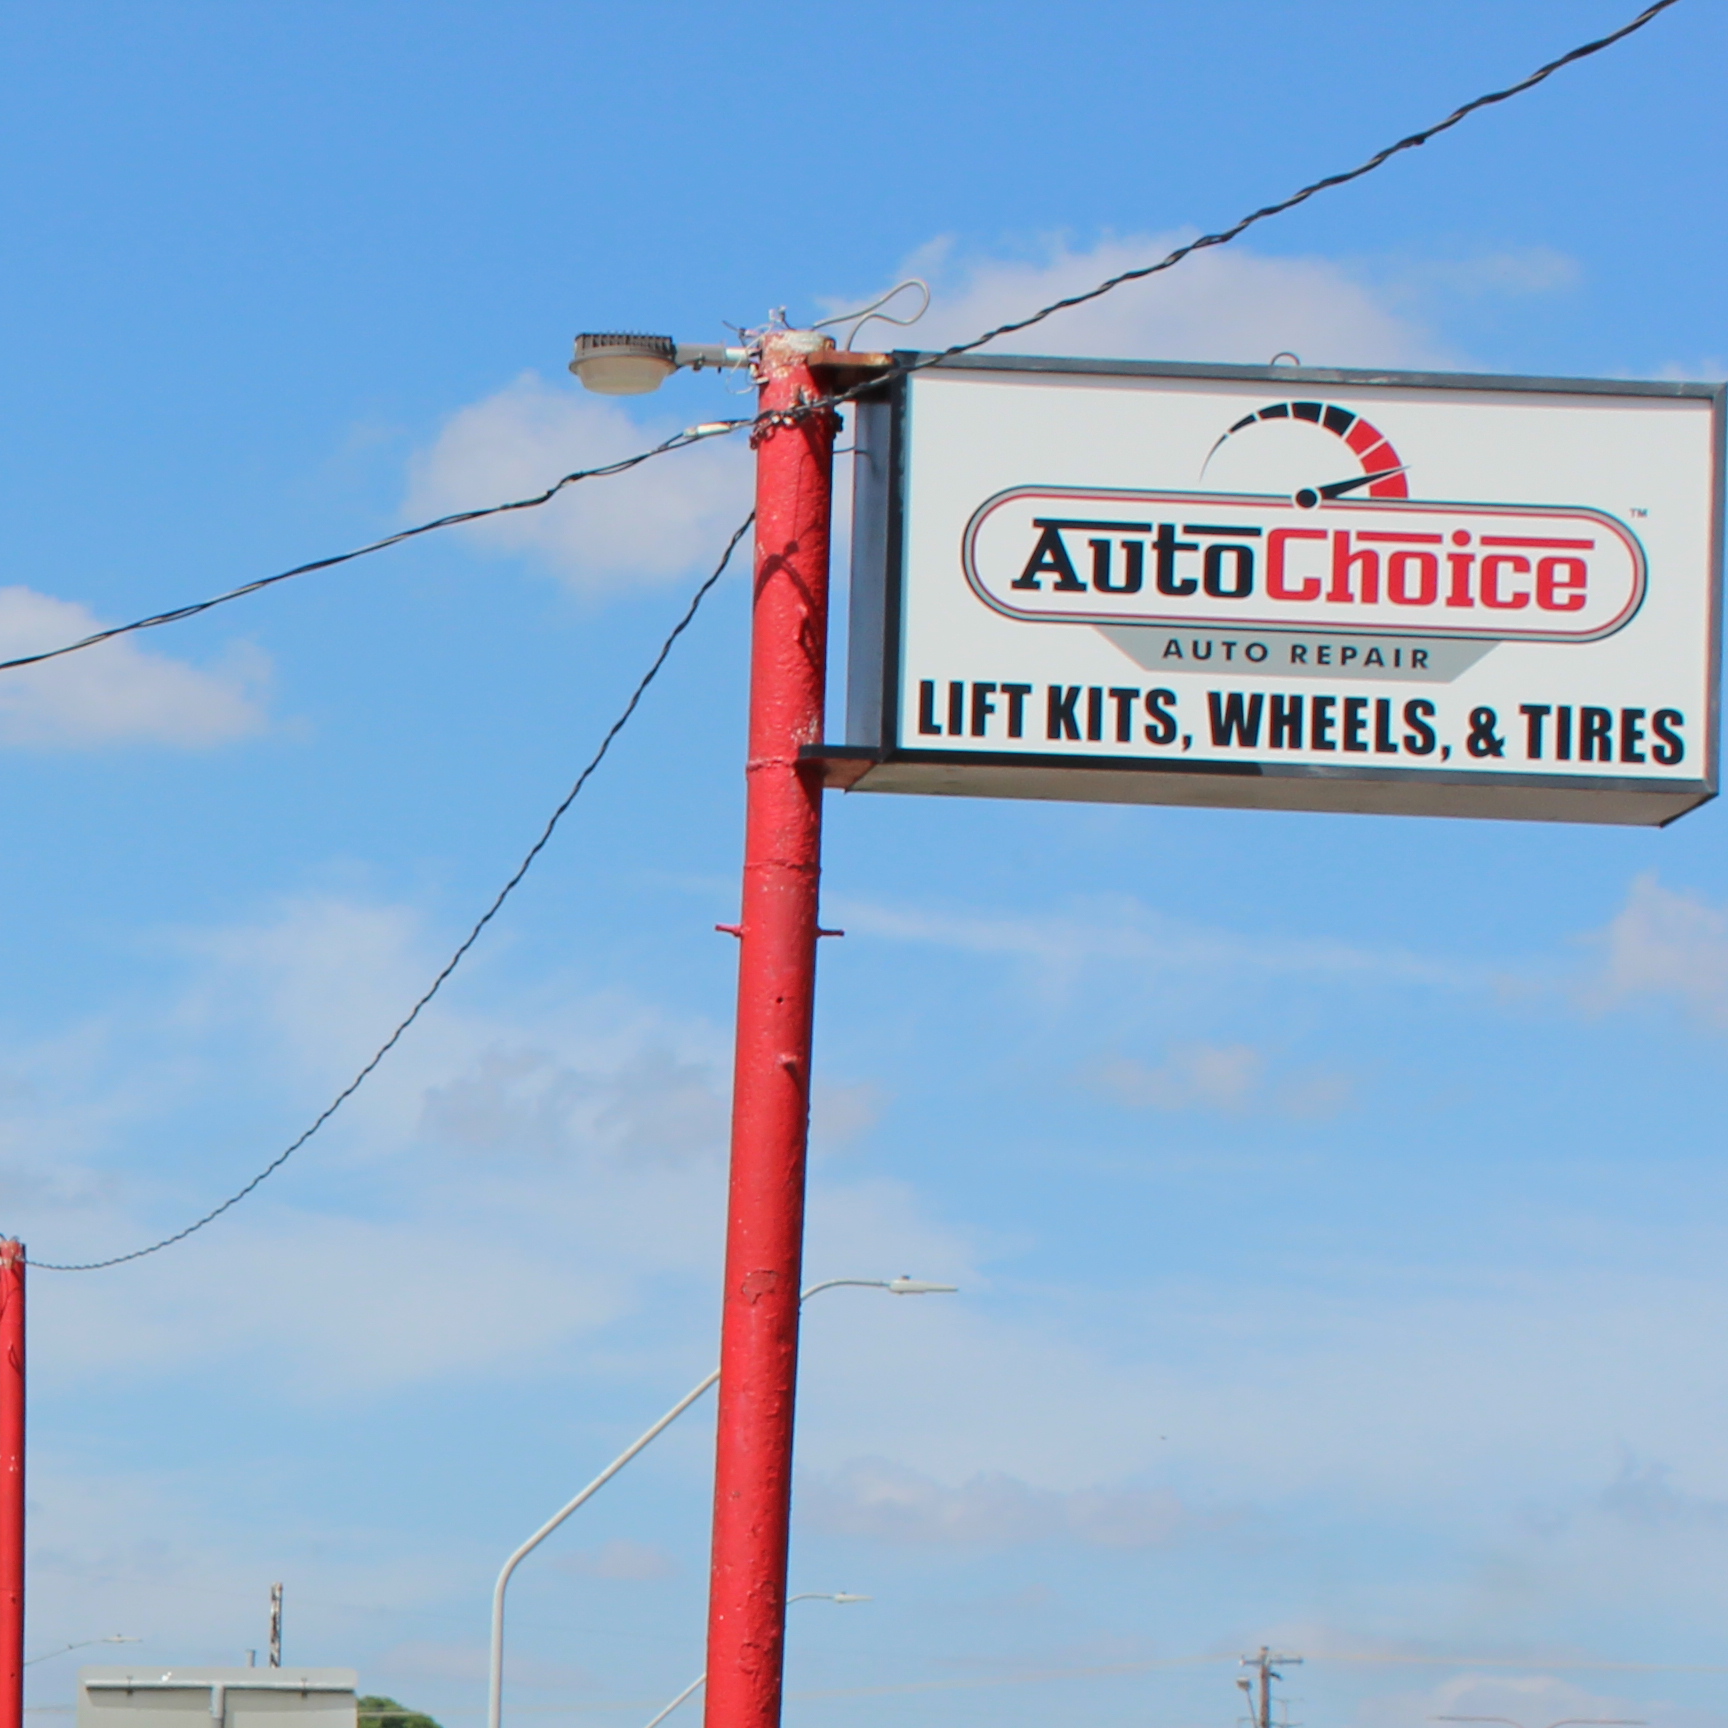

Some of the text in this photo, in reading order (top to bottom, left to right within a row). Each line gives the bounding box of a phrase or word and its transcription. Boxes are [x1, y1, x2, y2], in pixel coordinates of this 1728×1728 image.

[1010, 516, 1597, 613] AutoChoice
[1161, 637, 1432, 672] AUTO REPAIR
[917, 679, 1687, 767] LIFT KITS, WHEELS, & TIRES
